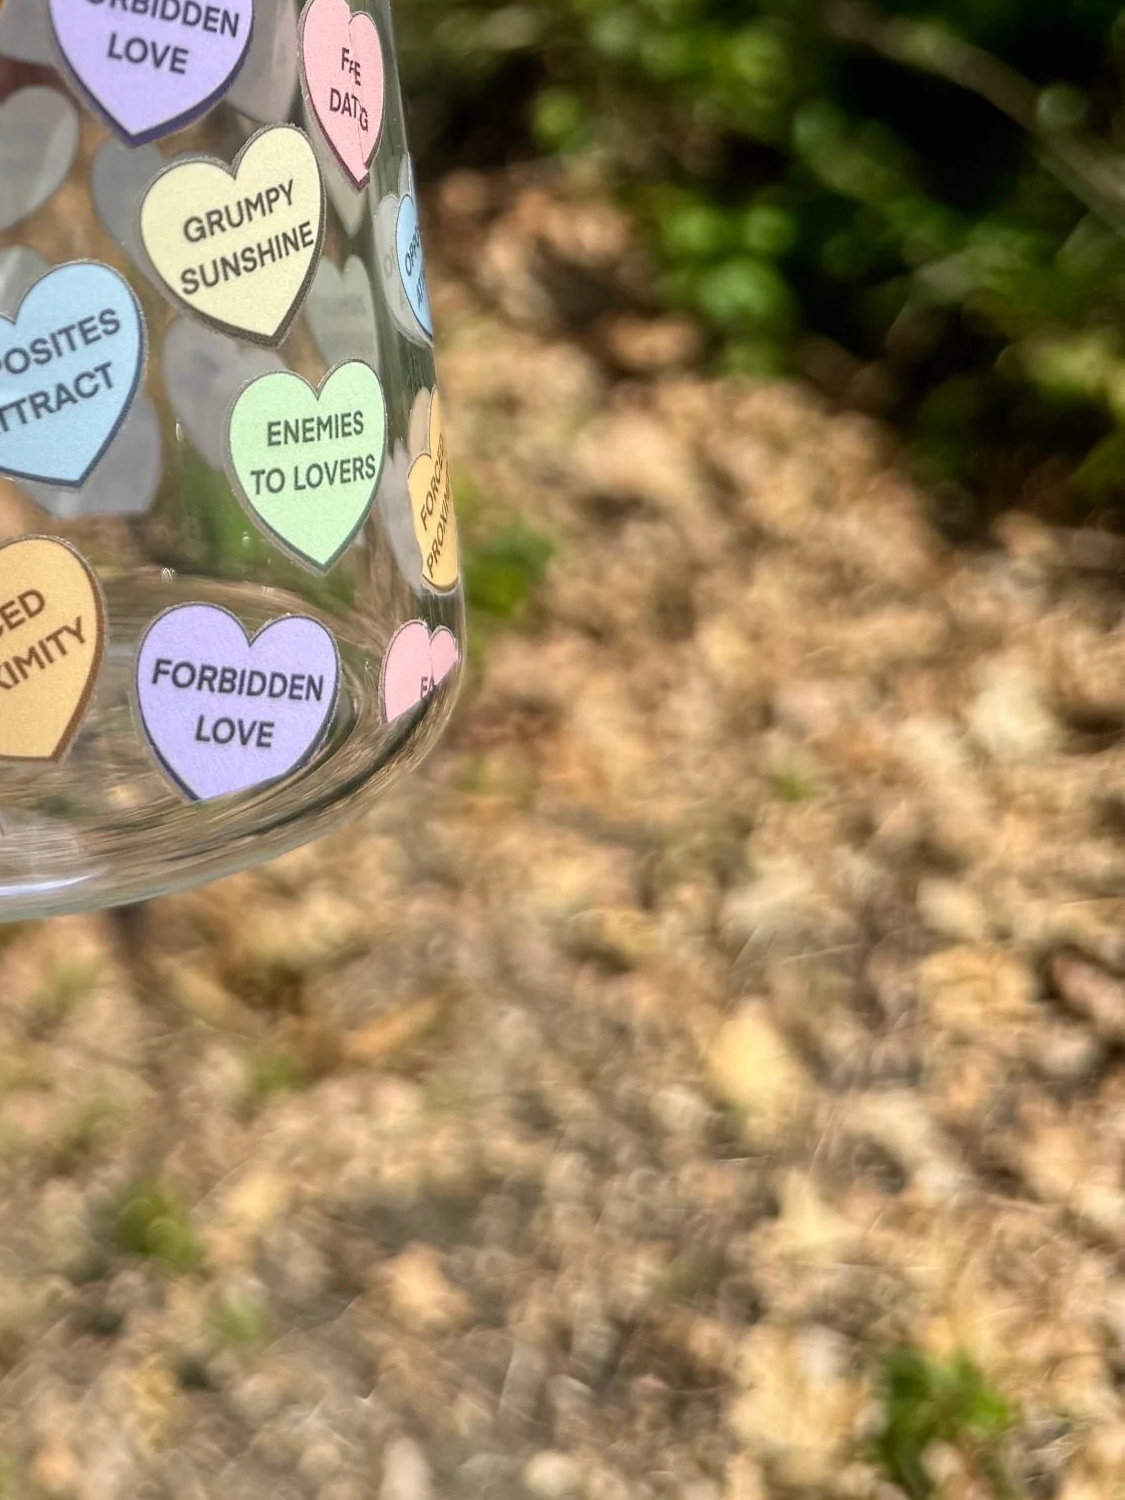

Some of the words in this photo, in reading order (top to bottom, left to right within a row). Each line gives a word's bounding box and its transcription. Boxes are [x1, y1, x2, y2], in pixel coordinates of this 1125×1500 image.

[107, 32, 189, 75] LOVE
[183, 180, 295, 243] GRUMPY
[180, 222, 315, 296] SUNSHINE
[267, 411, 364, 447] ENEMIES
[251, 467, 285, 496] TO
[294, 455, 376, 492] LOVERS
[152, 658, 324, 702] FORBIDDEN
[195, 715, 275, 748] LOVE
